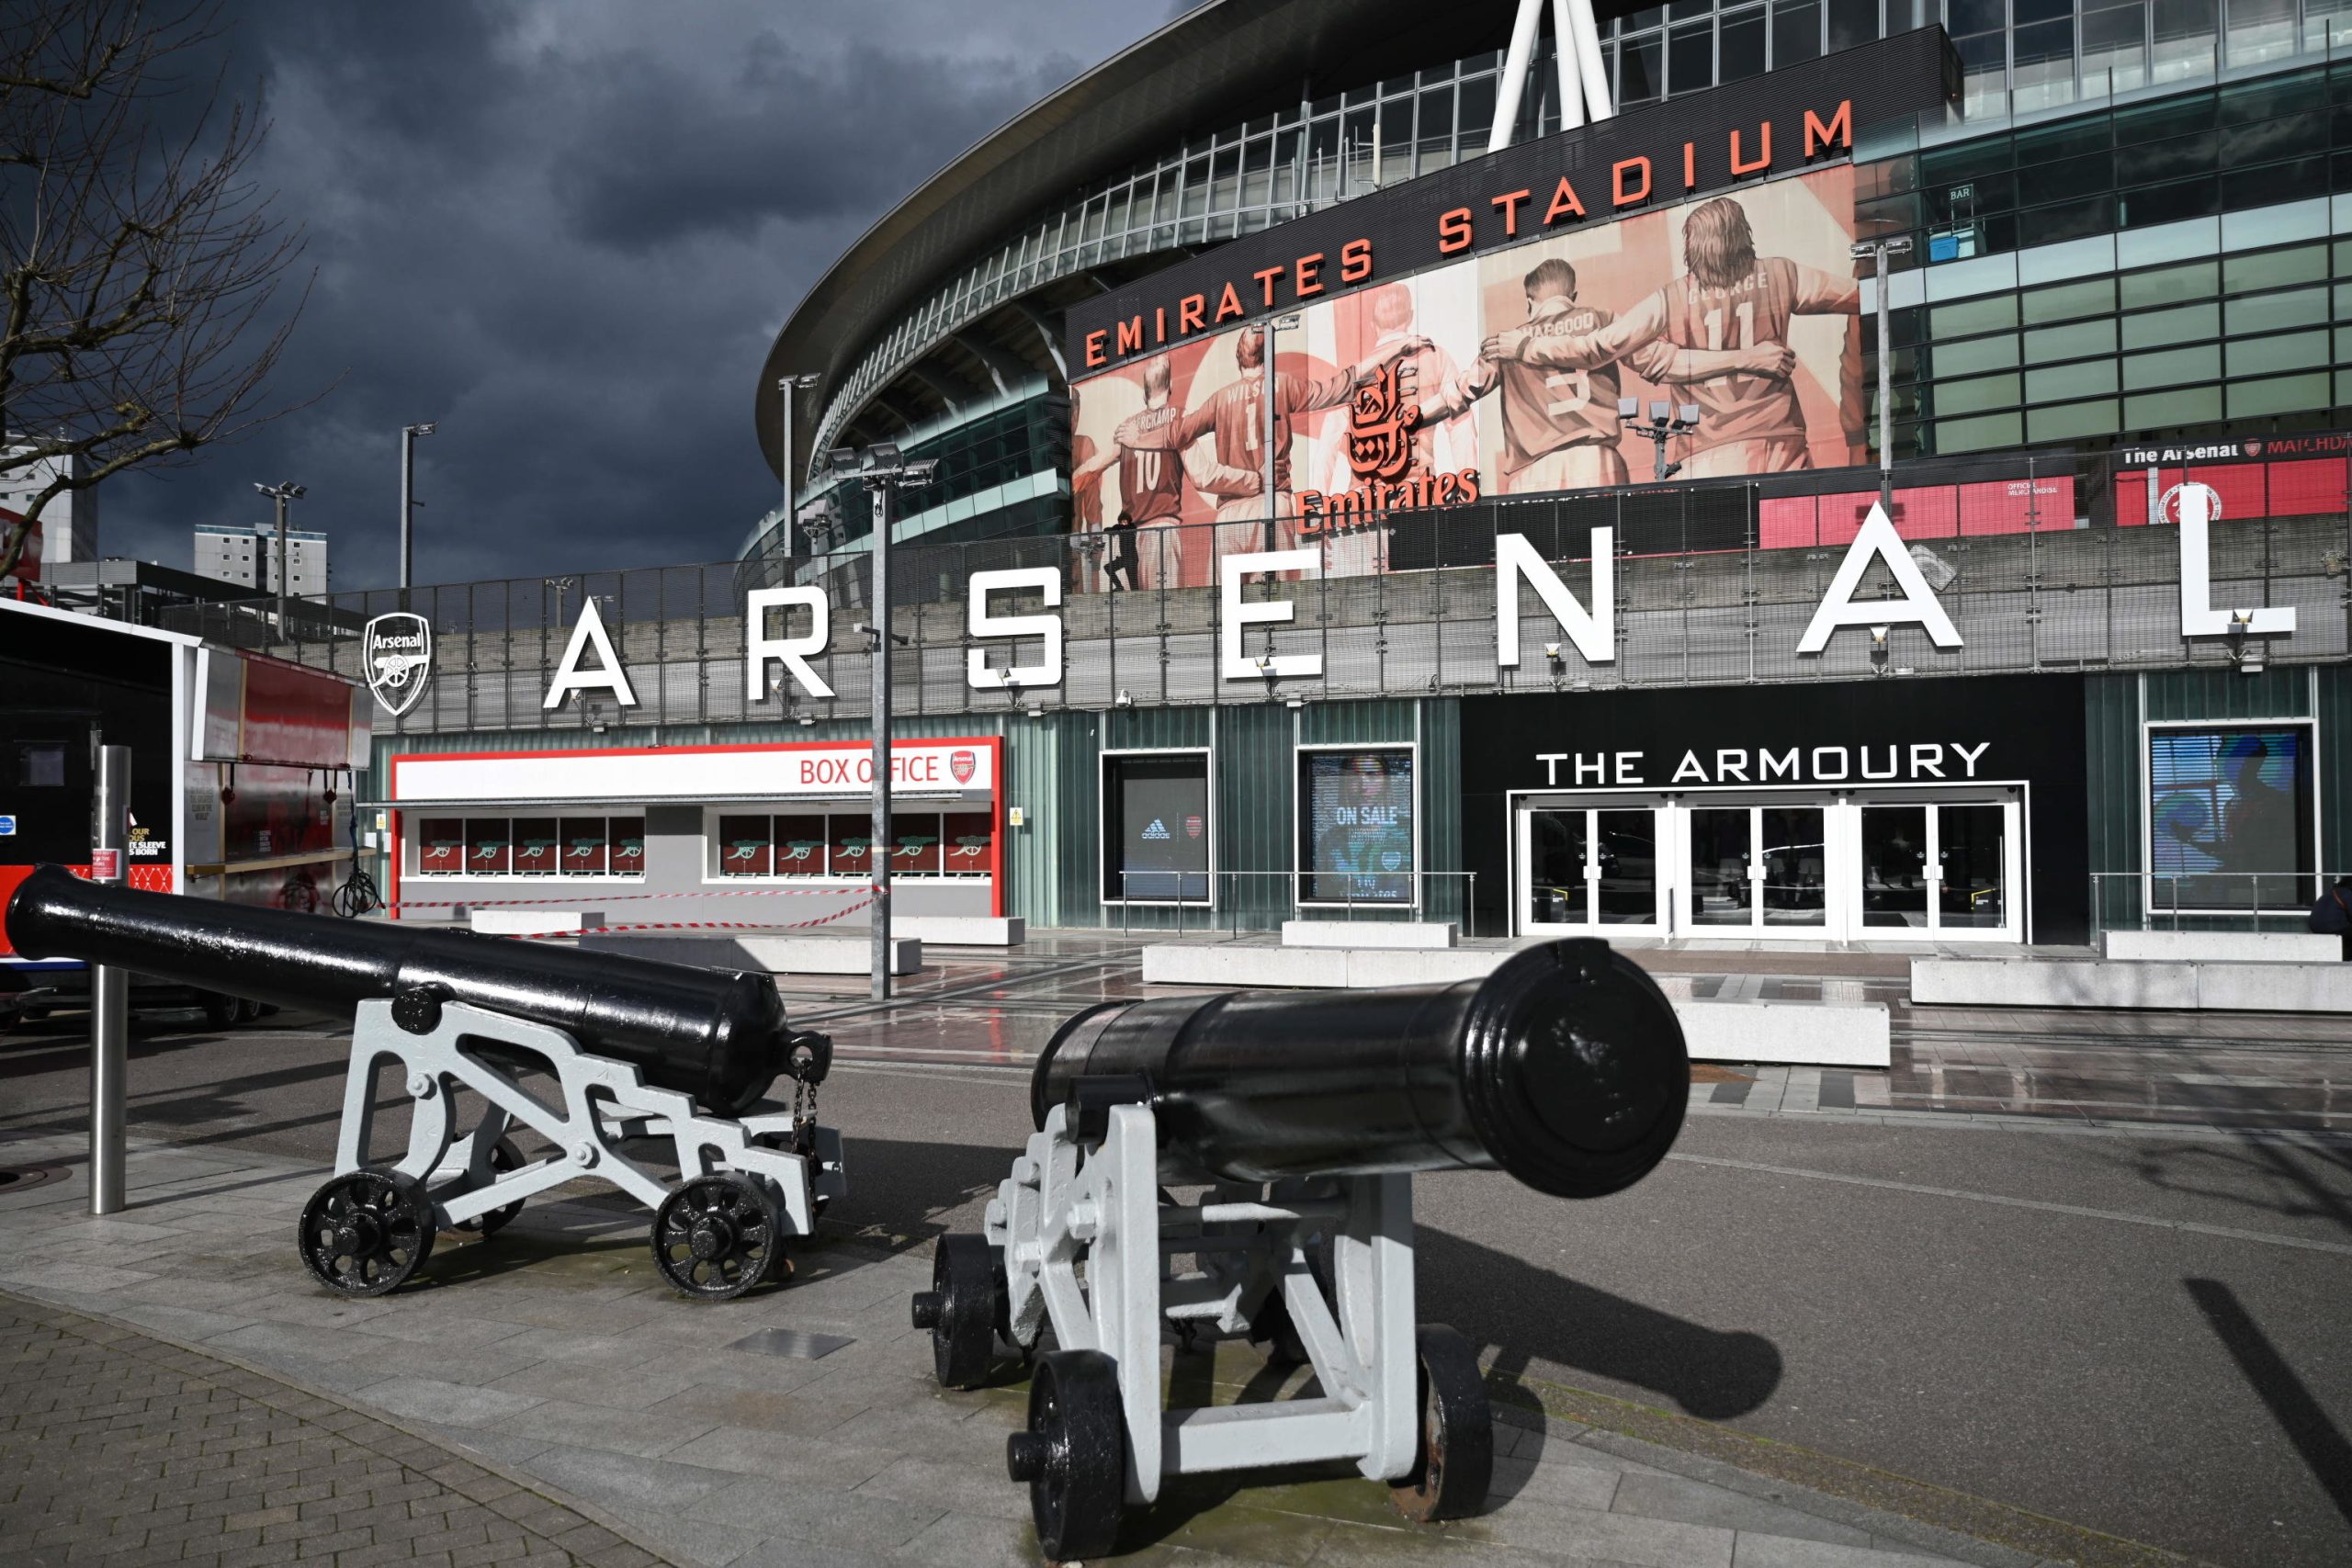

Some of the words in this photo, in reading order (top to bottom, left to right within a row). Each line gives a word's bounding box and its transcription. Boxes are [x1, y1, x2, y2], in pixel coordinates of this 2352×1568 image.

[1950, 188, 1970, 200] BAR
[1085, 238, 1373, 367] EMIRATES
[1439, 99, 1853, 253] STADIUM
[2122, 447, 2158, 464] The
[2162, 444, 2239, 461] Arsenal
[1294, 468, 1480, 535] Emirates
[543, 484, 2297, 709] ARSENAL
[373, 632, 421, 649] Arsenal
[800, 759, 850, 784] BOX
[856, 756, 939, 784] OFICE
[1535, 750, 1645, 784] THE
[1670, 742, 1991, 783] ARMOURY
[1336, 807, 1357, 825] ON
[1361, 806, 1397, 825] SALE
